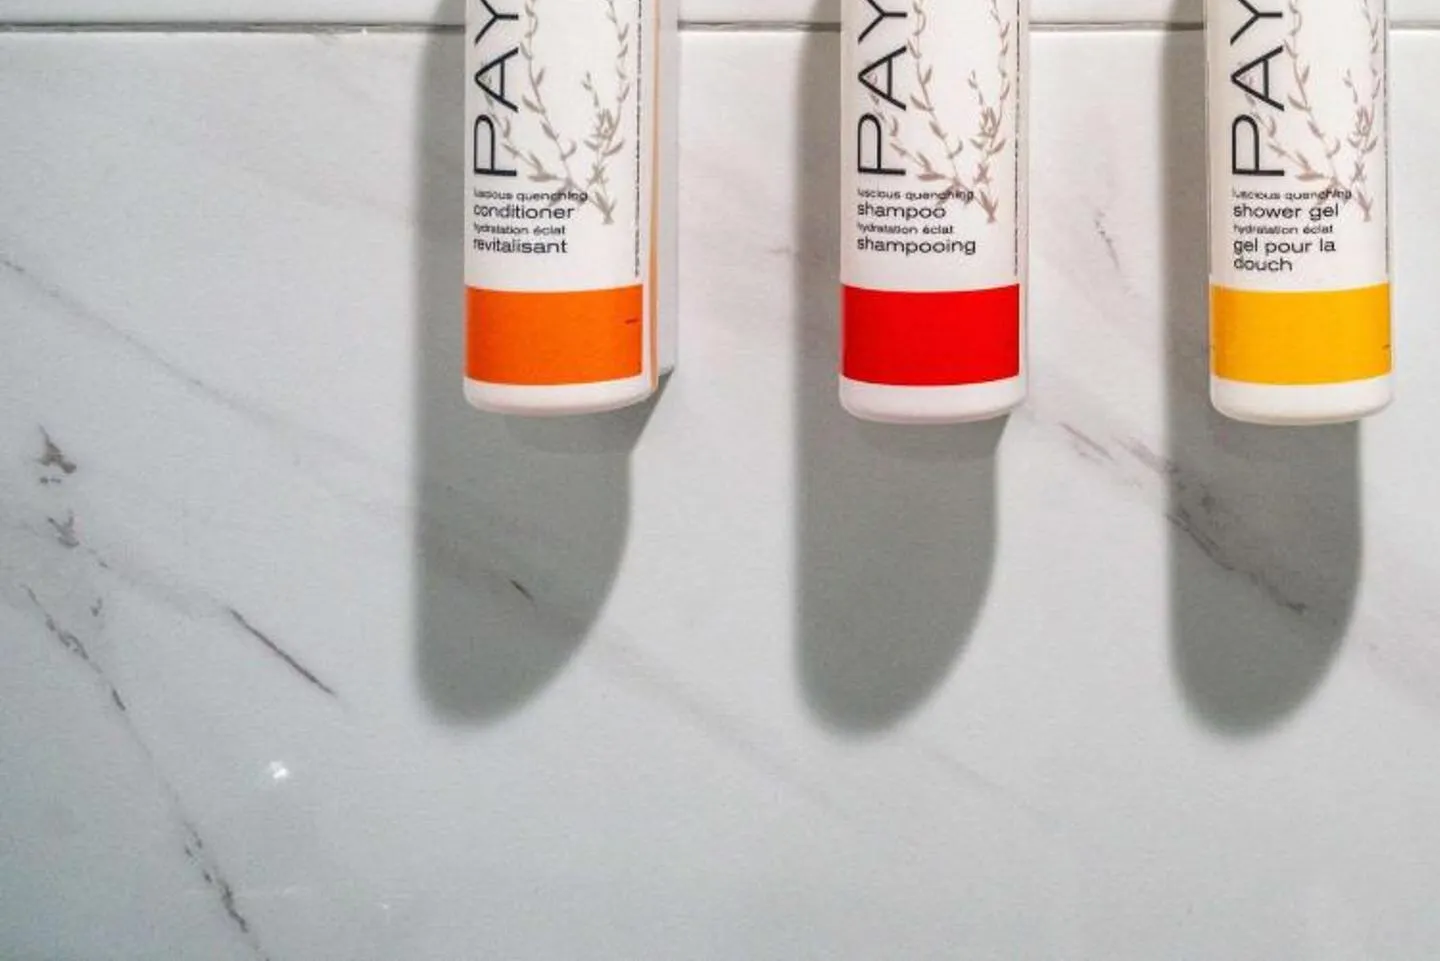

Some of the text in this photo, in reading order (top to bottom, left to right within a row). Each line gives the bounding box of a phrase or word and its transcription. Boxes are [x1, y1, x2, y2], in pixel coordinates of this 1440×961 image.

[473, 188, 588, 204] luscious quenching
[857, 188, 974, 203] luscious quenching
[1232, 187, 1352, 203] luscious quenching
[473, 203, 575, 219] conditioner
[857, 201, 947, 221] shampoo
[1233, 202, 1339, 221] shower gel
[473, 223, 529, 235] hydratation
[857, 222, 918, 235] hydratation
[1233, 223, 1298, 235] hydratation
[473, 237, 568, 254] revitalisant
[857, 236, 976, 256] shampooing
[1233, 237, 1336, 256] gel pour la
[1233, 255, 1293, 272] douch
